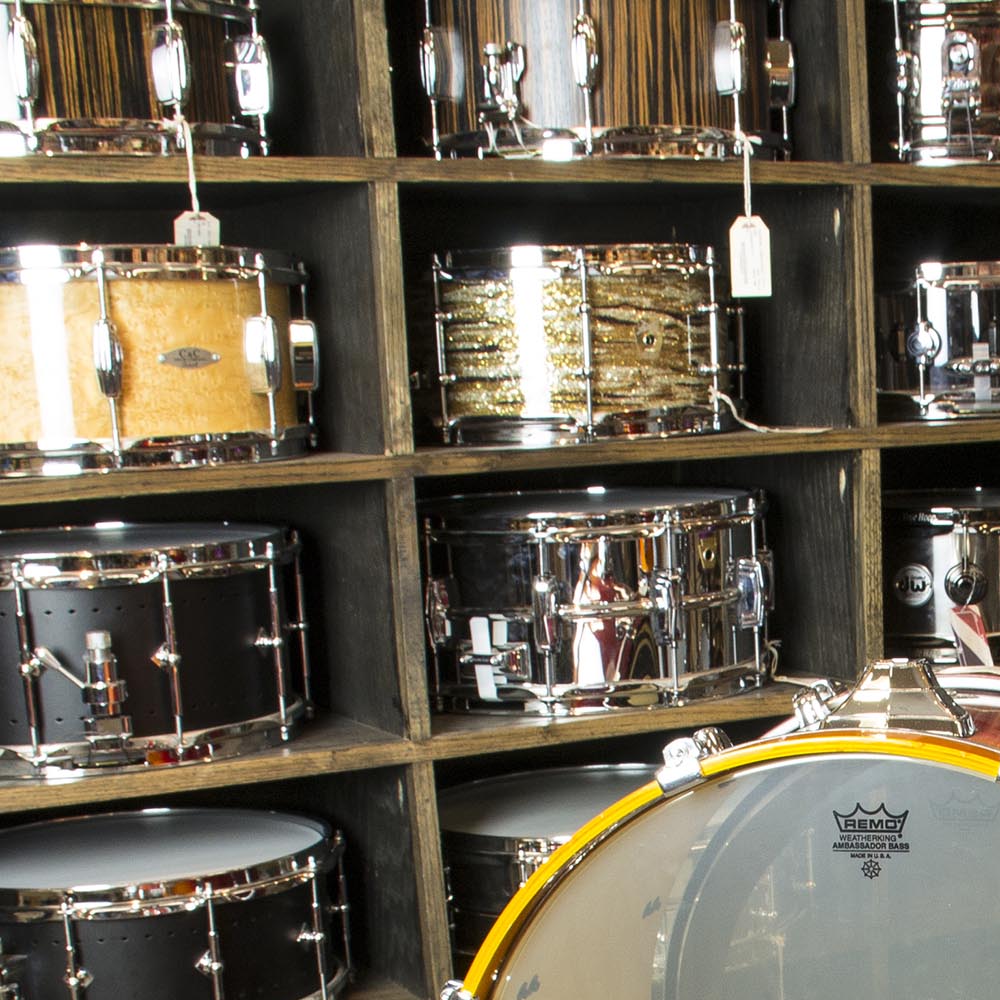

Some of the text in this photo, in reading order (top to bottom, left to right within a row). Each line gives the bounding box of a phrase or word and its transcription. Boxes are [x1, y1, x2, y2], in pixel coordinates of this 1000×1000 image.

[844, 819, 898, 830] REMO
[839, 834, 897, 842] WEATHERKING
[832, 842, 910, 850] AMBASSADOR BASS
